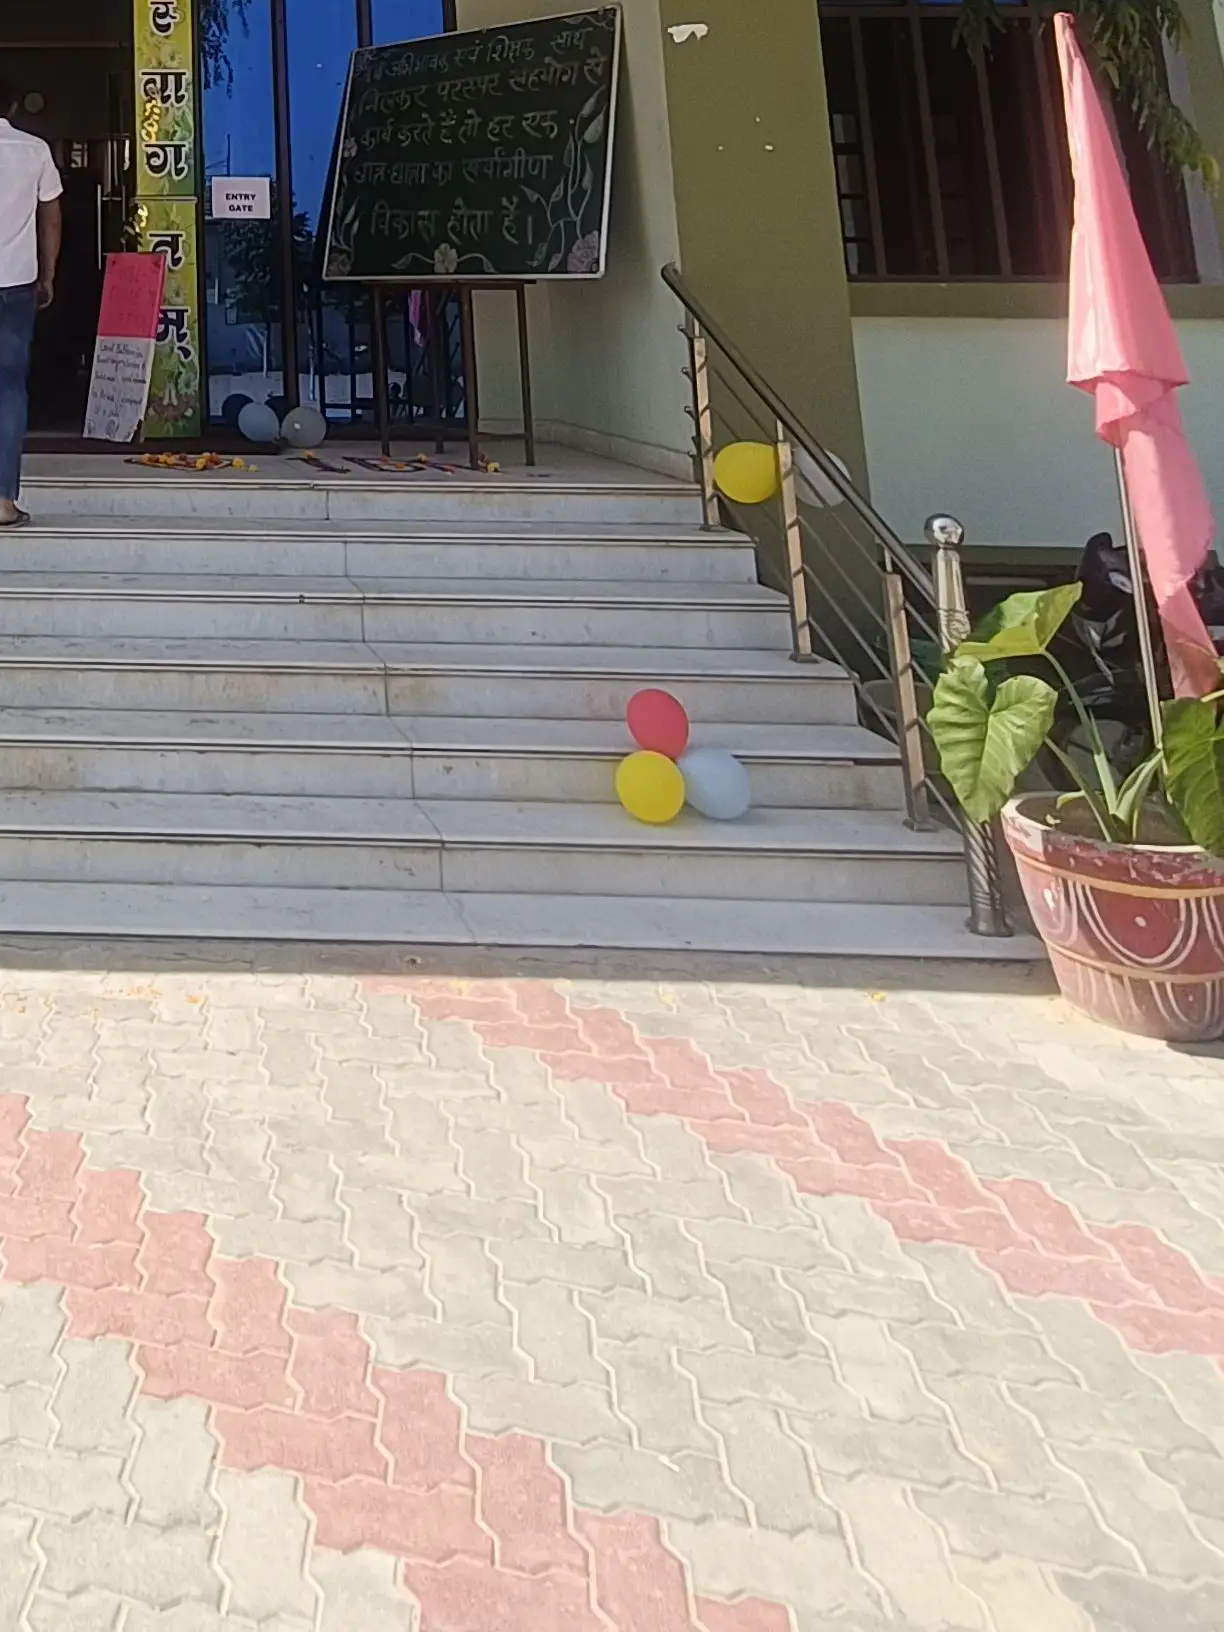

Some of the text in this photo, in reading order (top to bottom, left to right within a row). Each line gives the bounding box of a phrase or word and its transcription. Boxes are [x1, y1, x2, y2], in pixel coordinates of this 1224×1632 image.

[487, 115, 516, 142] हर
[225, 193, 257, 201] ENTRY
[228, 204, 254, 212] GATE
